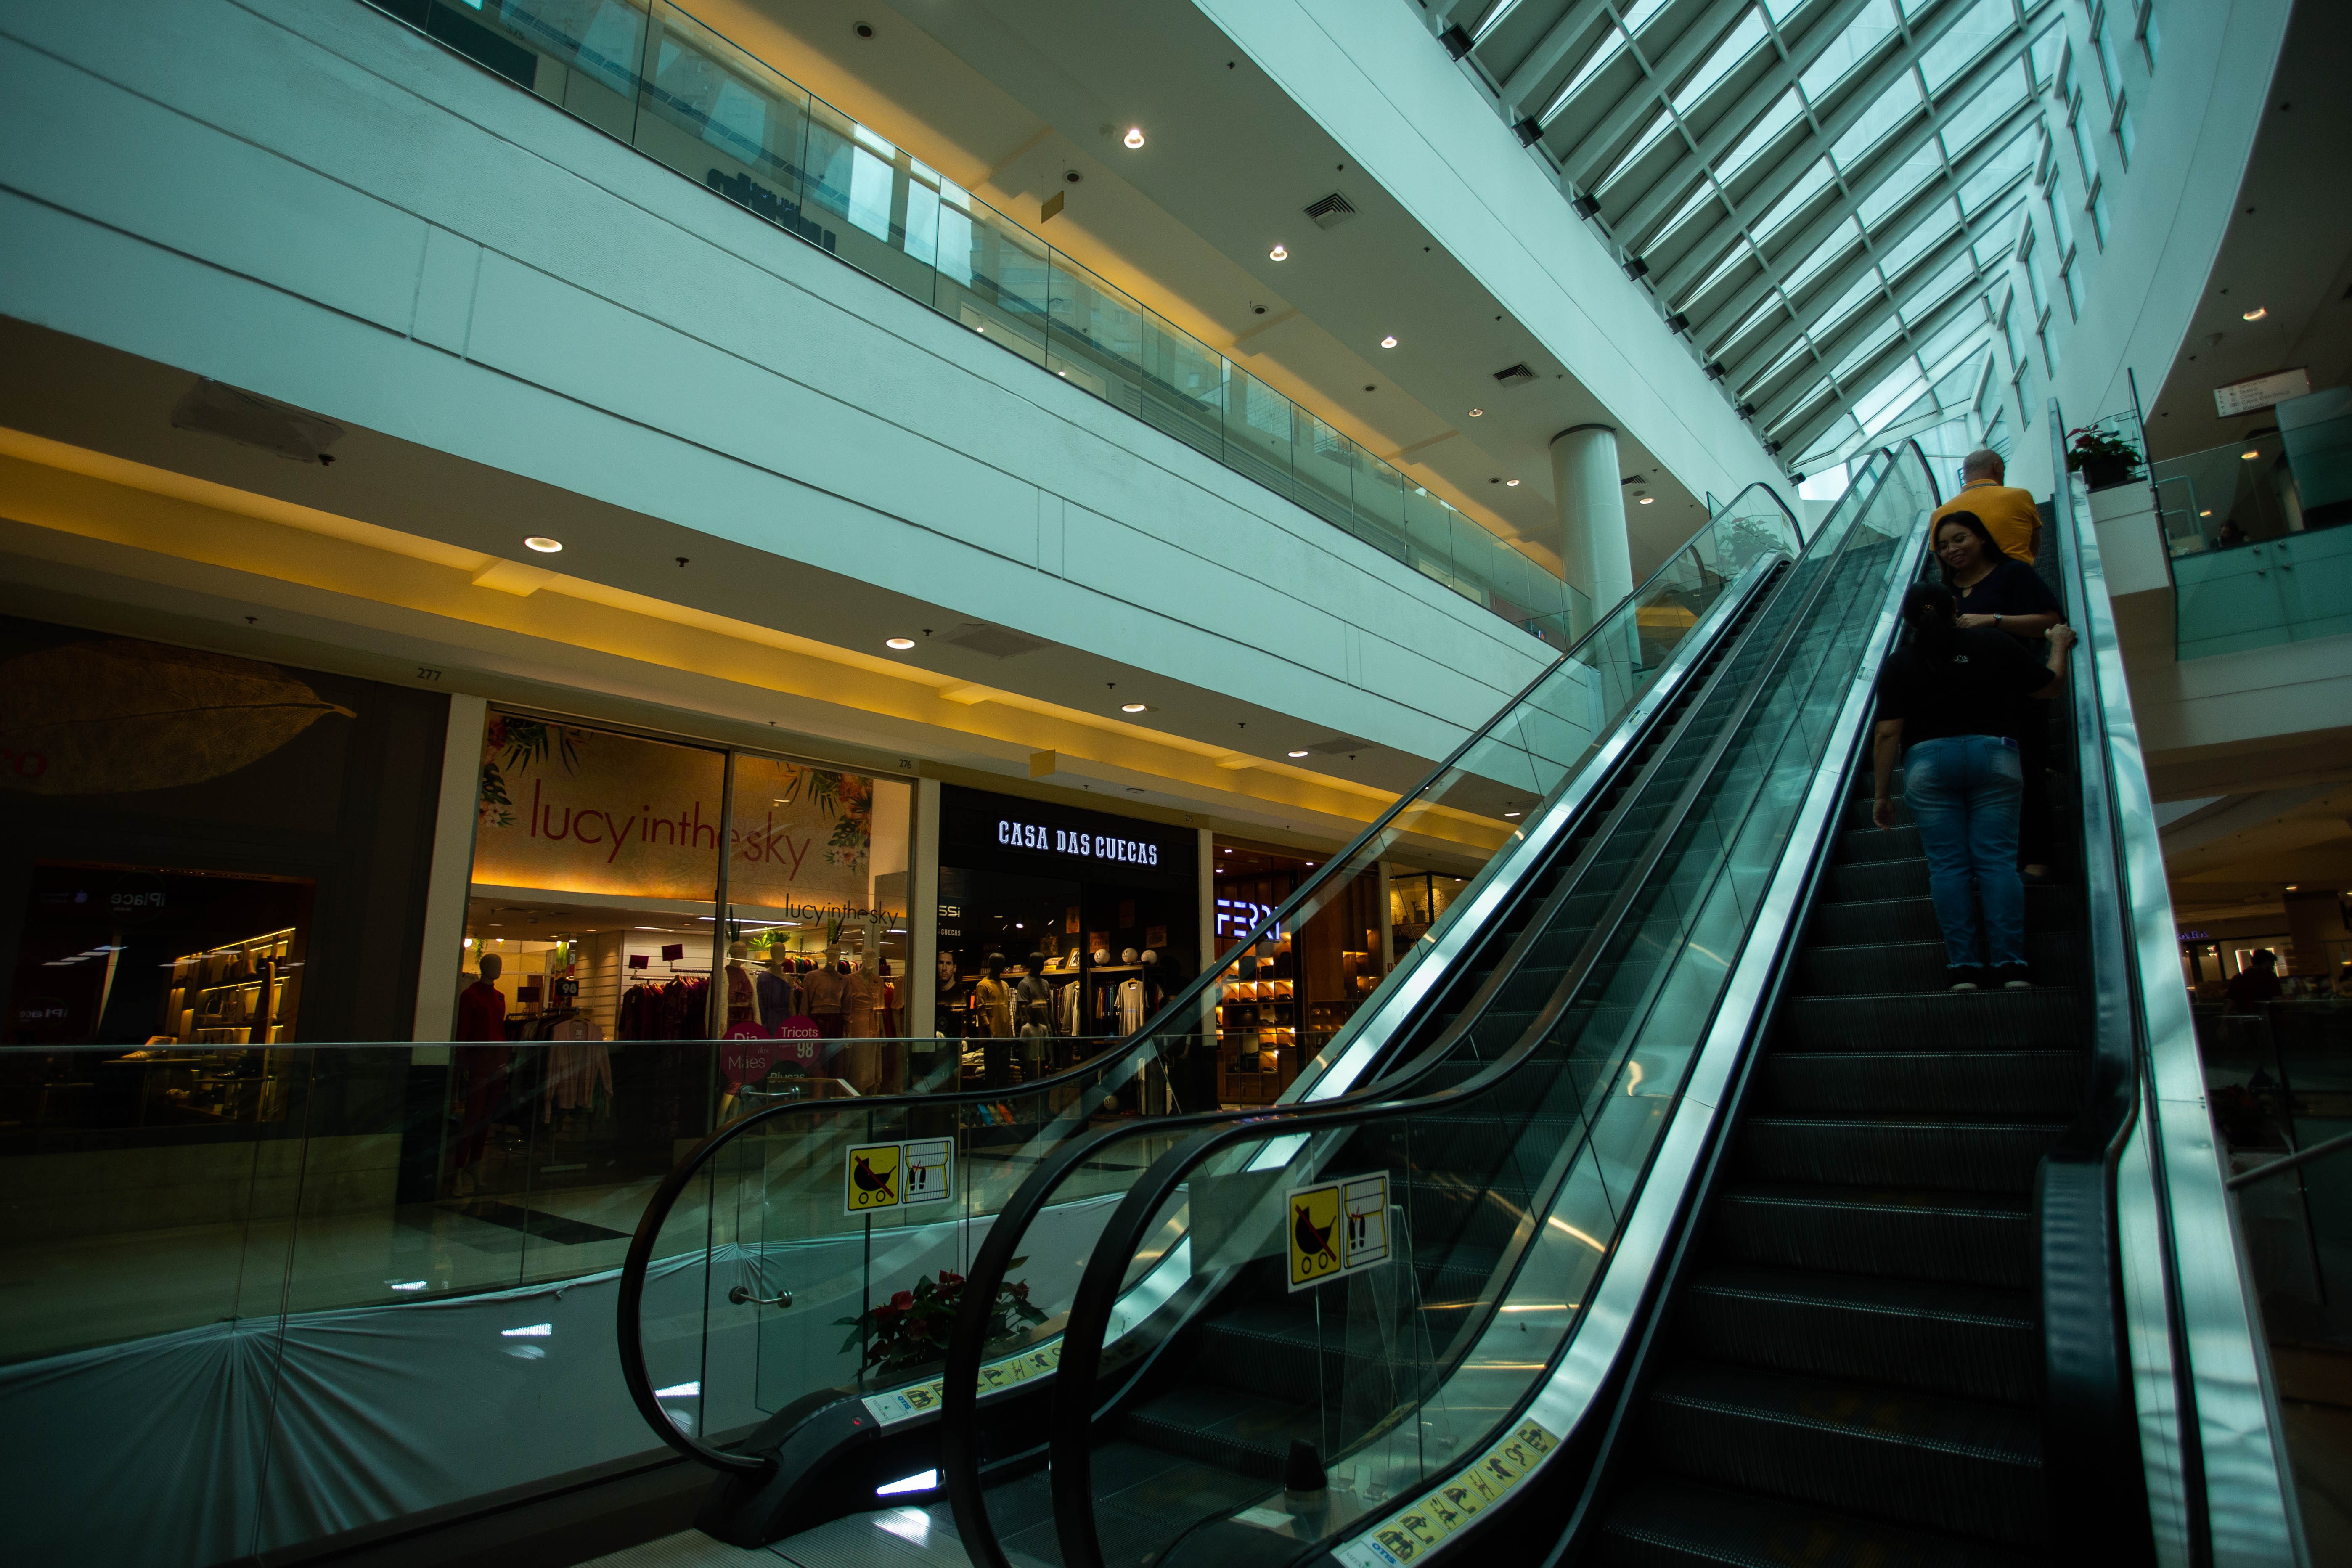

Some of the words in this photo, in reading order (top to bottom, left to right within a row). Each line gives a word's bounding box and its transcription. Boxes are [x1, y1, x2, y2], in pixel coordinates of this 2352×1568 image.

[2240, 391, 2263, 400] Cinema
[417, 667, 442, 681] 277
[899, 759, 911, 769] 276
[998, 820, 1049, 851] CASA
[1056, 829, 1090, 856] DAS
[1095, 836, 1158, 866] CUECAS
[562, 983, 577, 994] 98
[734, 1032, 758, 1045] Dia
[781, 1026, 818, 1038] Tricots
[797, 1042, 814, 1058] 98
[898, 1396, 911, 1409] OTIS
[1372, 1542, 1396, 1564] OTIS
